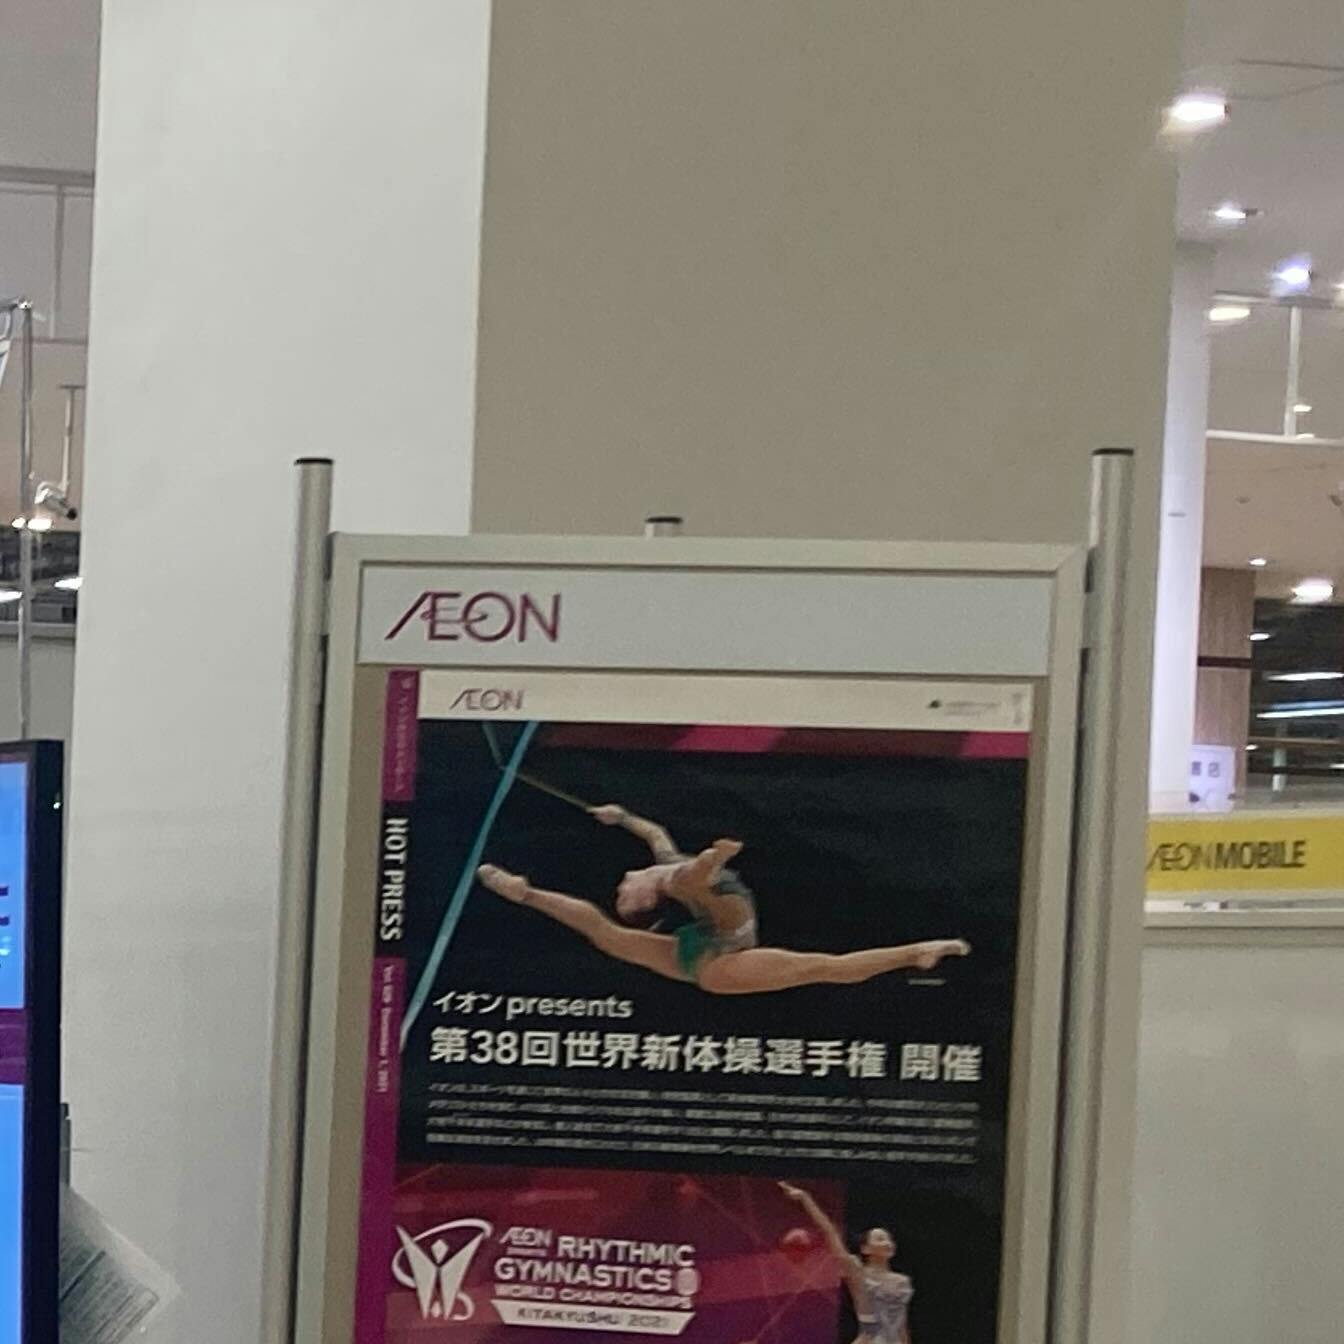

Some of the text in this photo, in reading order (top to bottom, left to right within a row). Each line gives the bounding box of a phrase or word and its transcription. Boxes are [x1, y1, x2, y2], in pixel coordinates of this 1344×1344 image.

[384, 817, 409, 866] HOT
[1214, 840, 1306, 870] MOBILE
[379, 869, 405, 941] PRESS
[433, 990, 634, 1021] イオン presents
[429, 1026, 983, 1082] 第38回世界新体操選手権 開催
[557, 1235, 696, 1267] RHYTHMIC
[494, 1257, 673, 1292] GYMNASTICS
